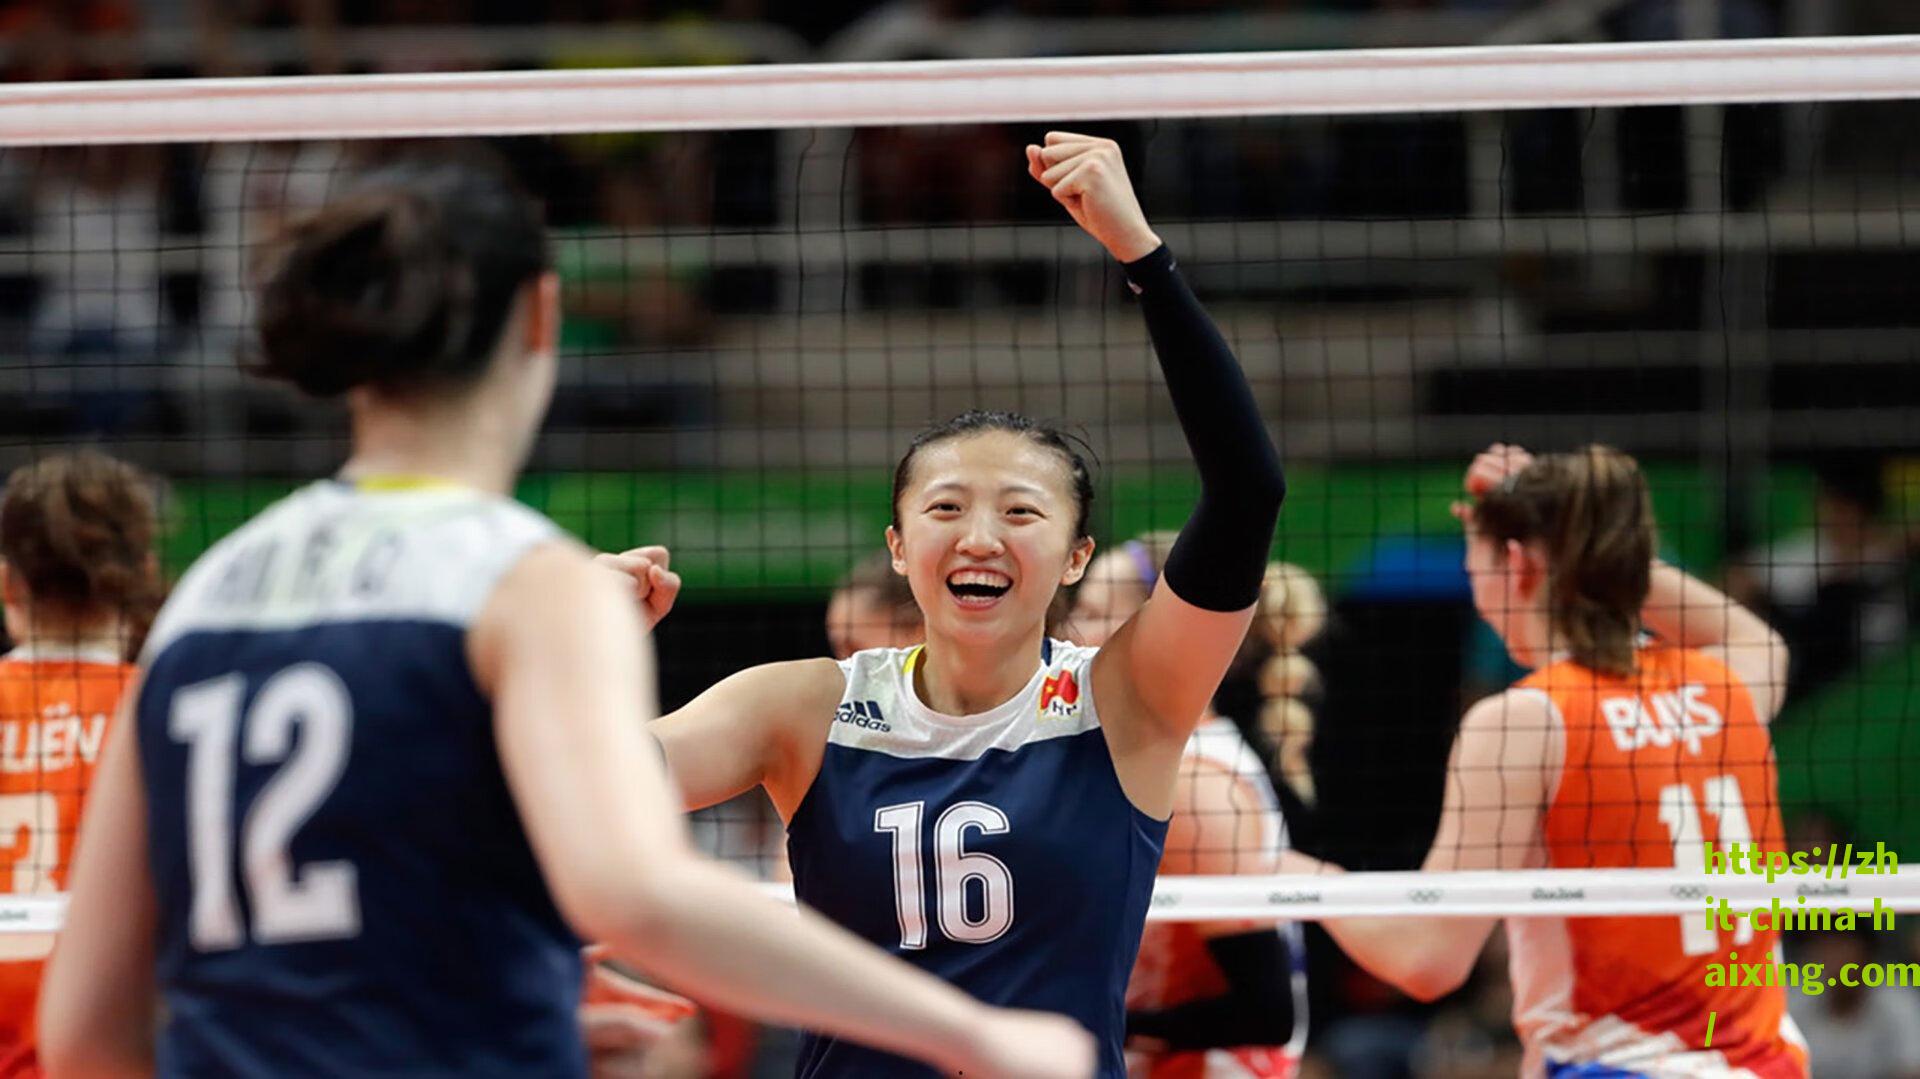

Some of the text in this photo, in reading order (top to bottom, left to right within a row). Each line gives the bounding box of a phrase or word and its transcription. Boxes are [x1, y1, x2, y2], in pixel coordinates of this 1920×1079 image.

[0, 702, 106, 774] LIËN
[167, 661, 361, 953] 12
[873, 800, 1014, 950] 16
